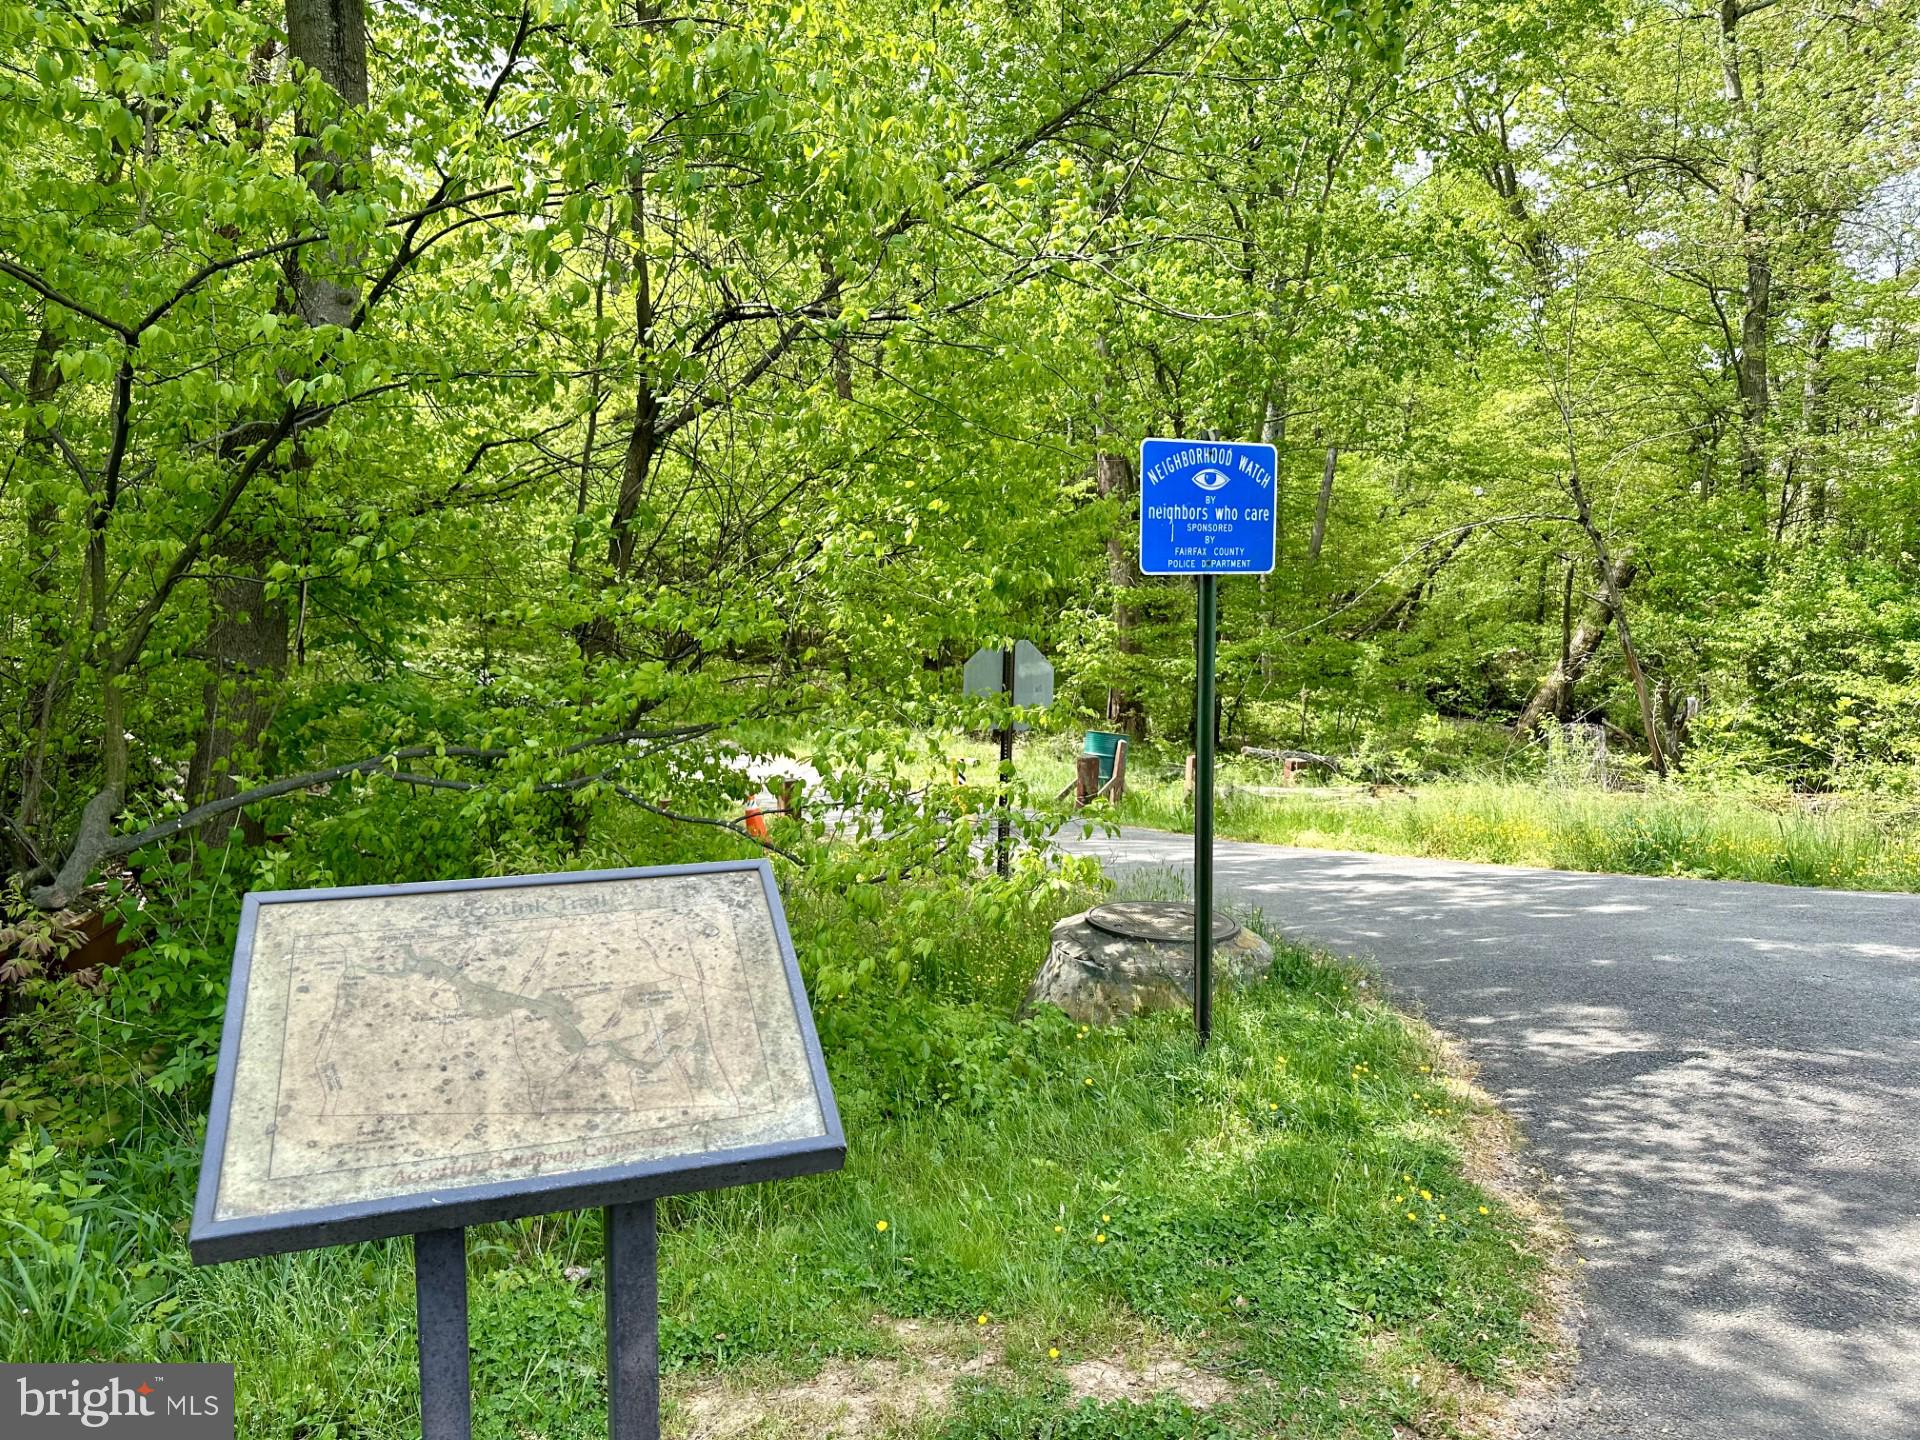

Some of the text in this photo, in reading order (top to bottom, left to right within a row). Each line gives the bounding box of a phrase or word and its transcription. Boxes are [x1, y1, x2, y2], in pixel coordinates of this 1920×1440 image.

[1147, 447, 1271, 489] NEIGHBORHOOD WATCH
[1205, 496, 1216, 504] BY
[1148, 503, 1270, 523] neighbors who care
[1187, 523, 1233, 532] SPONSORED
[1205, 536, 1215, 544] BY
[1175, 547, 1245, 556] FAIRFAX COUNTY
[1168, 559, 1251, 568] POLICE DPARTMENT
